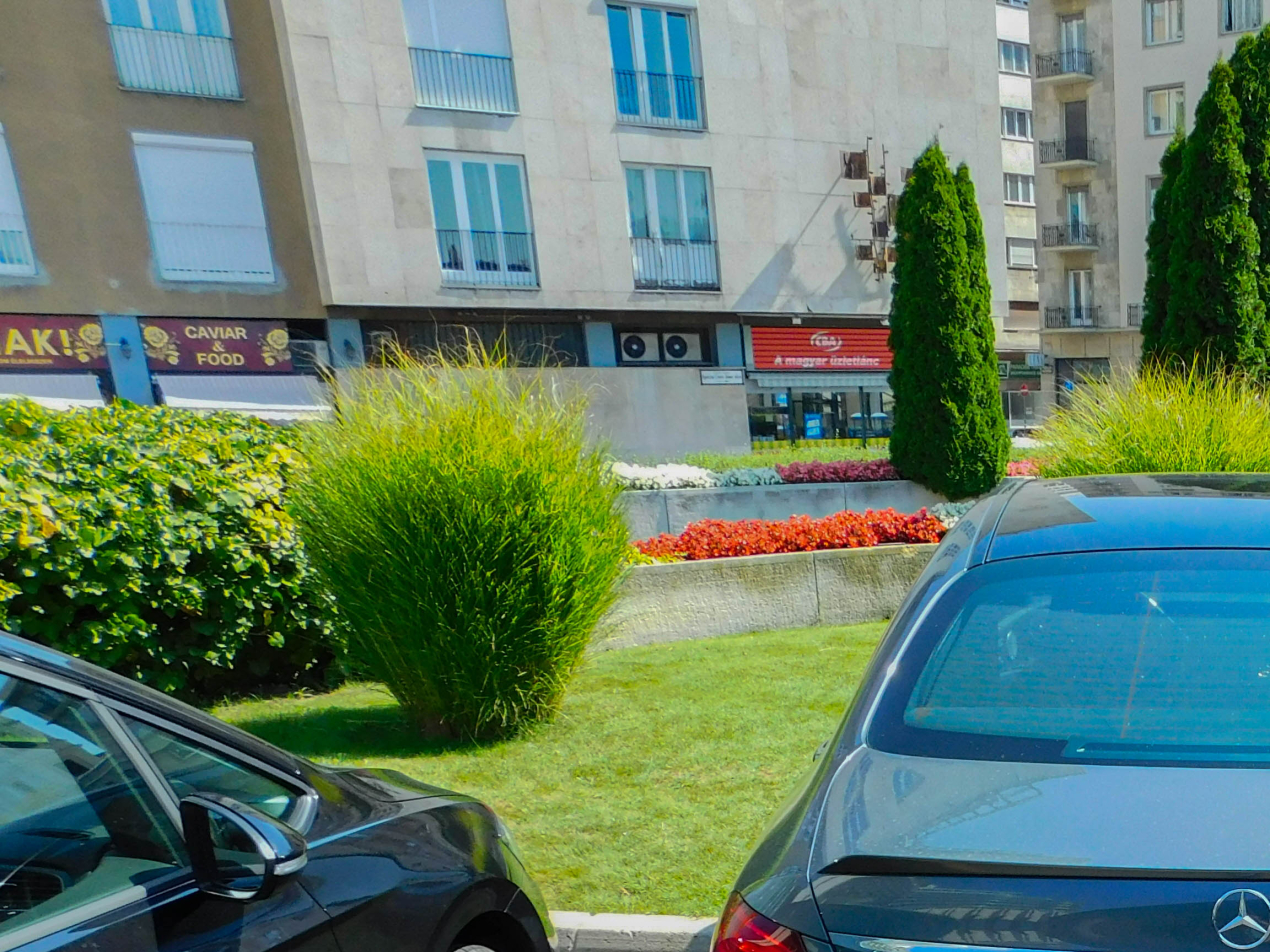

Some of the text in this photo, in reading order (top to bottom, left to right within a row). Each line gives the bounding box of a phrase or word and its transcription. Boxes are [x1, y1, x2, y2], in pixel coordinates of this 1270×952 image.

[185, 326, 247, 339] CAVIAR
[0, 328, 73, 356] AK!
[212, 341, 225, 352] &
[196, 353, 244, 366] FOOD
[774, 355, 782, 365] A
[785, 357, 828, 367] magyar
